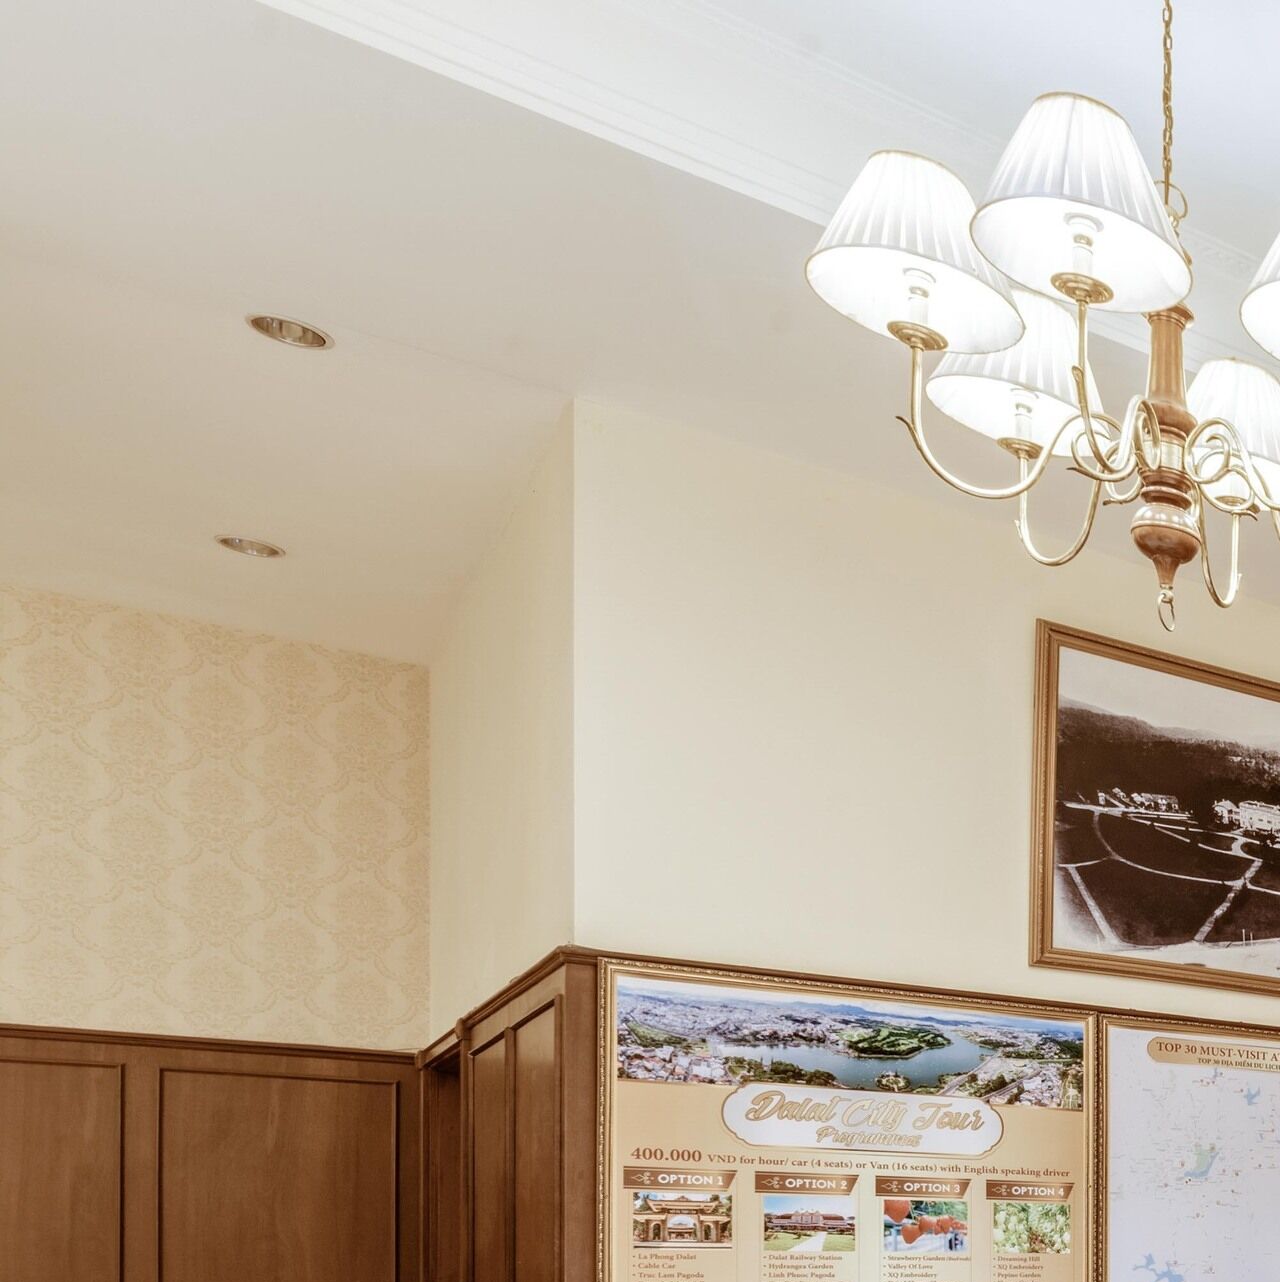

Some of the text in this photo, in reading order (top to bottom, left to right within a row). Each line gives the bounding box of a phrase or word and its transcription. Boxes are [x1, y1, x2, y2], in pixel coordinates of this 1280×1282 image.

[1157, 1042, 1182, 1053] TOP
[1200, 1047, 1267, 1060] MUST-VISIT
[746, 1090, 985, 1131] Dalat City Tour
[632, 1148, 702, 1162] 400.000
[708, 1154, 736, 1163] VND
[740, 1156, 756, 1164] for
[759, 1156, 788, 1166] hour/
[811, 1160, 820, 1168] (4
[824, 1160, 852, 1169] seats)
[964, 1165, 998, 1175] English
[1001, 1168, 1041, 1178] speaking
[658, 1174, 723, 1185] OPTION 1
[785, 1178, 847, 1189] OPTION 2
[904, 1182, 960, 1192] OPTION 3
[1012, 1186, 1064, 1196] OPTION 4
